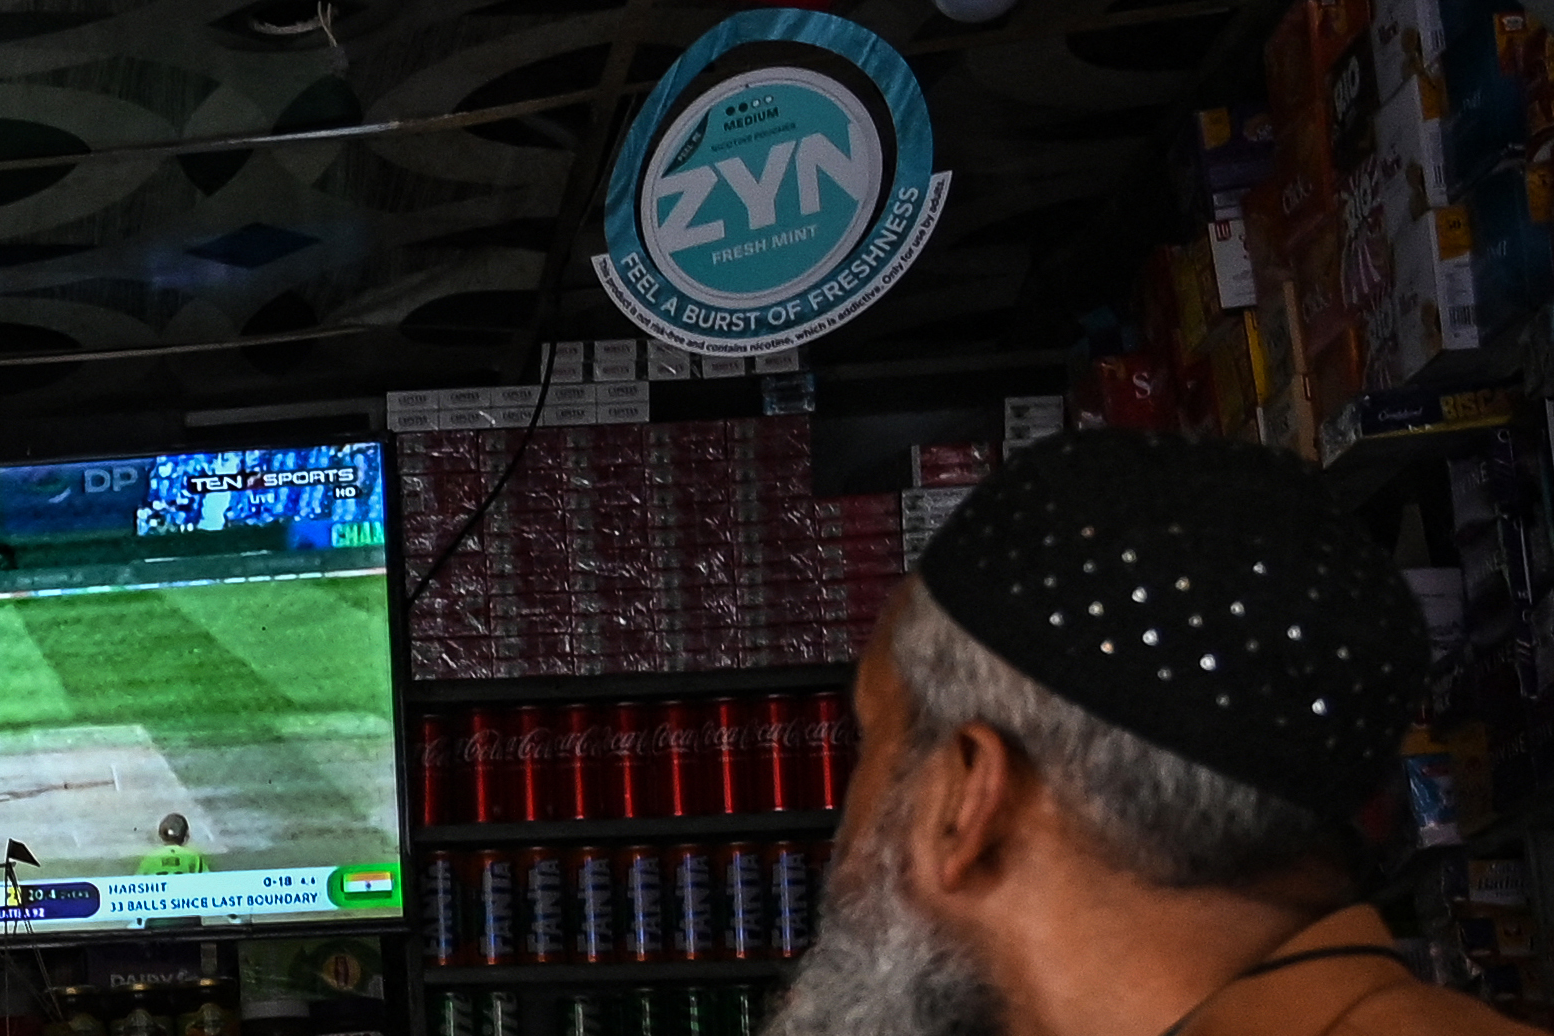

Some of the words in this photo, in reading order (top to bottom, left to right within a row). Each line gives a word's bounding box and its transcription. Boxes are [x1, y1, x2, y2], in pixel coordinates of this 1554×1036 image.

[724, 107, 779, 131] MEDIUM
[654, 121, 868, 252] ZYN
[712, 238, 766, 265] FRESH
[771, 224, 817, 248] MINT
[620, 251, 661, 303] FEEL
[661, 297, 678, 316] A
[682, 308, 761, 332] BURST
[767, 300, 801, 326] OF
[807, 186, 919, 311] FRESHNESS
[606, 277, 631, 309] product
[637, 312, 651, 327] not
[651, 321, 686, 345] risk-free
[686, 338, 706, 351] and
[706, 342, 747, 353] contains
[750, 336, 794, 352] nicotine,
[795, 321, 826, 341] which
[827, 316, 837, 327] is
[838, 285, 884, 321] addictive.
[882, 262, 904, 284] Only
[901, 248, 915, 264] for
[912, 230, 927, 248] use
[920, 214, 935, 231] by
[83, 465, 139, 493] DP
[191, 475, 242, 493] TEN
[262, 468, 354, 487] SPORTS
[335, 486, 357, 498] HD
[108, 882, 167, 895] HARSHIT
[263, 876, 292, 888] 0-18
[127, 899, 167, 911] BALLS
[170, 897, 209, 910] SINCE
[211, 896, 243, 908] LAST
[247, 892, 318, 906] BOUNDARY
